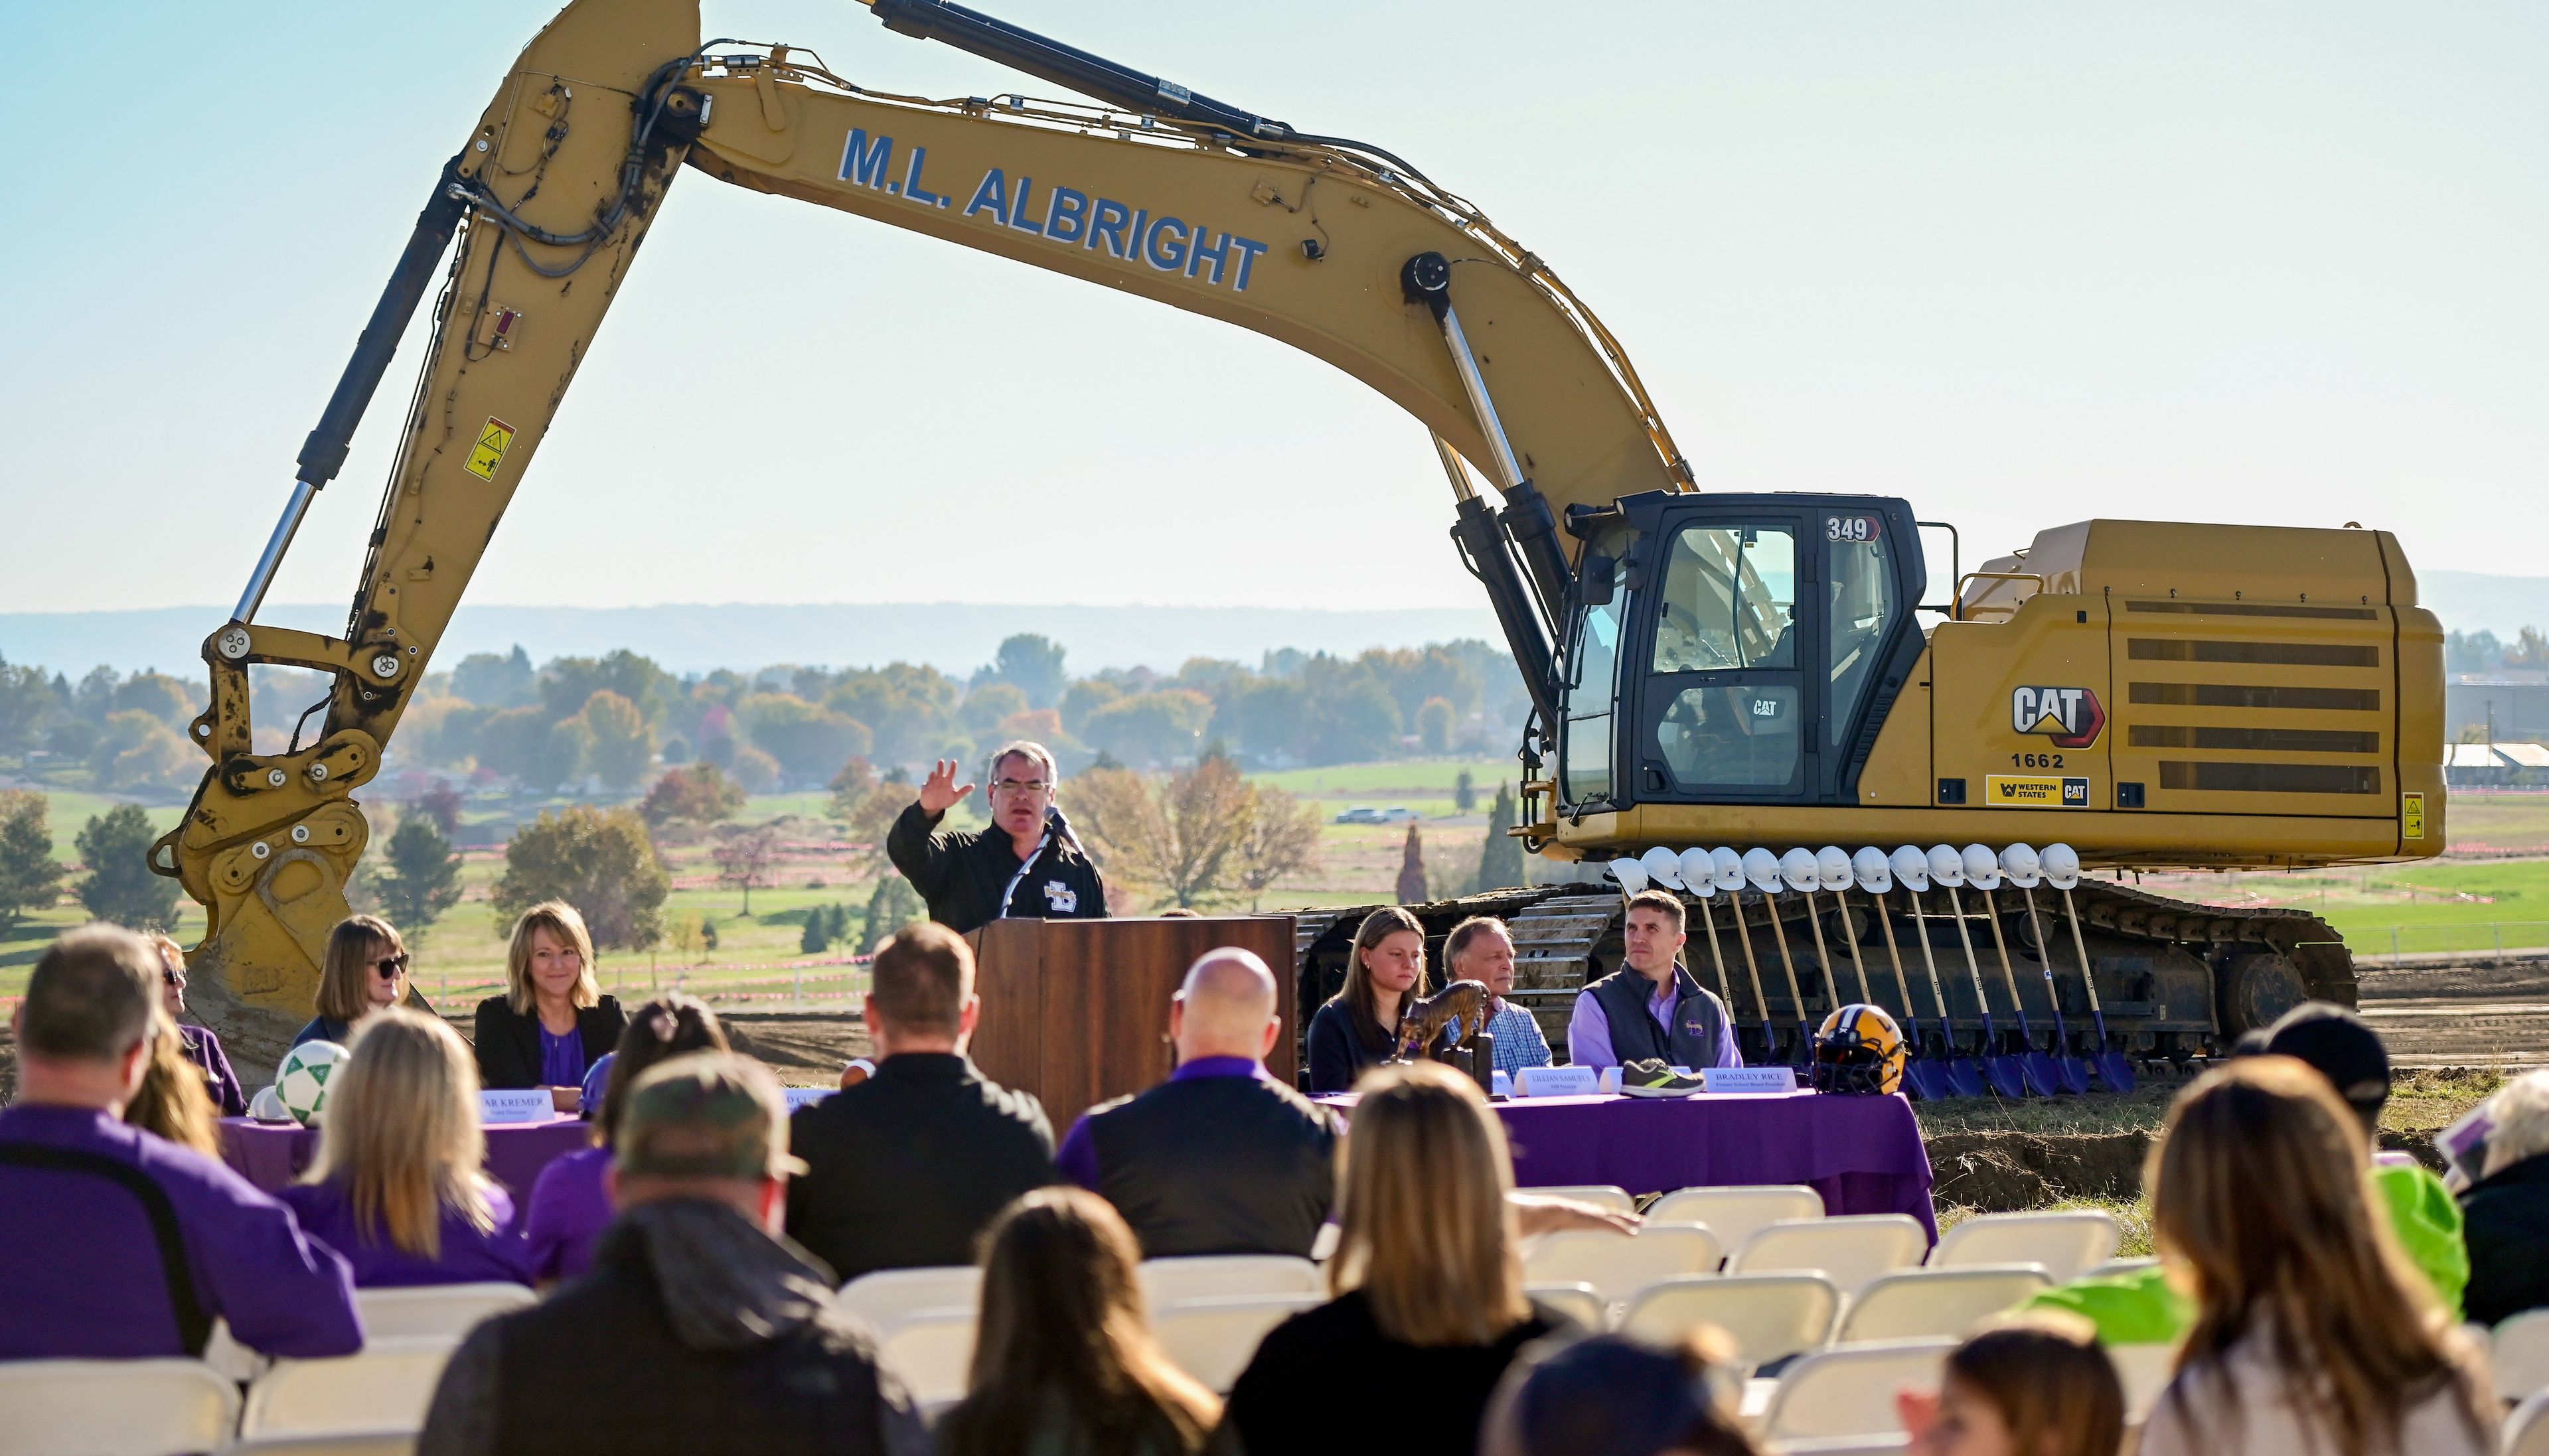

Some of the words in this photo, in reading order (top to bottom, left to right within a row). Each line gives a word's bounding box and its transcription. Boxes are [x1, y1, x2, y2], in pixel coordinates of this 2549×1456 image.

[837, 127, 951, 209] M.L.
[963, 167, 1269, 293] ALBRIGHT
[1827, 518, 1867, 541] 349
[1753, 699, 1777, 716] CAT
[2014, 687, 2082, 733] CAT
[2011, 753, 2064, 768] 1662
[2064, 784, 2085, 799] CAT
[501, 1098, 544, 1107] KREMER
